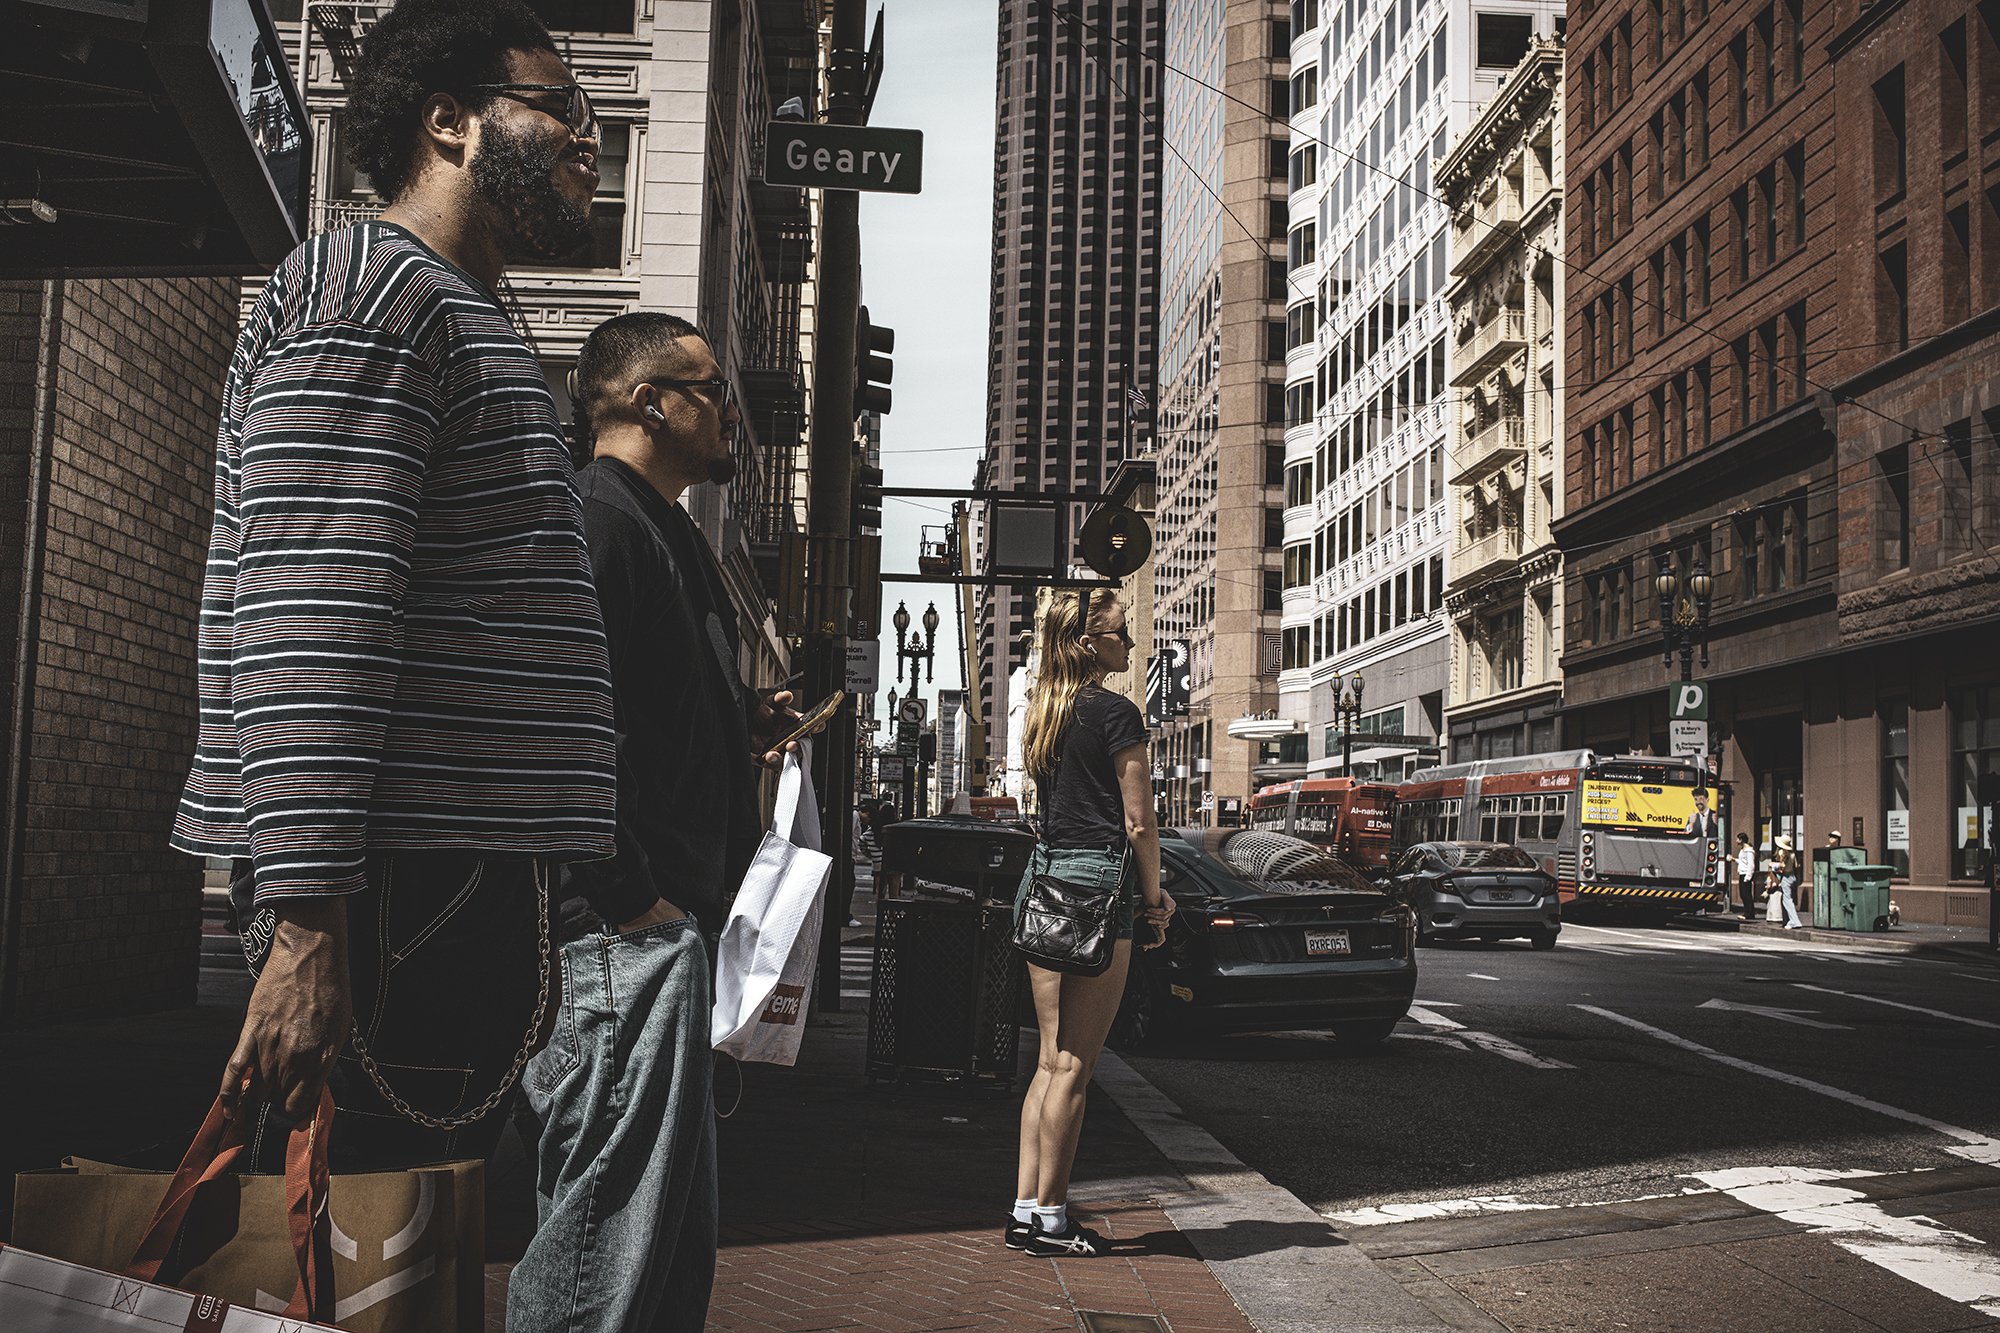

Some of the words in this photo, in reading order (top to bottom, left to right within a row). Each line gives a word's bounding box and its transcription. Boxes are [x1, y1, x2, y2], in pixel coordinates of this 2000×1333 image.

[785, 138, 902, 184] Geary
[845, 645, 863, 654] nion
[845, 654, 868, 664] quare
[845, 676, 872, 685] 'Farrell
[864, 732, 873, 791] TUXEDOS
[1350, 806, 1384, 816] AI-native
[1646, 813, 1683, 825] PostHog
[1309, 937, 1347, 951] 8XRE053
[764, 995, 799, 1015] reme
